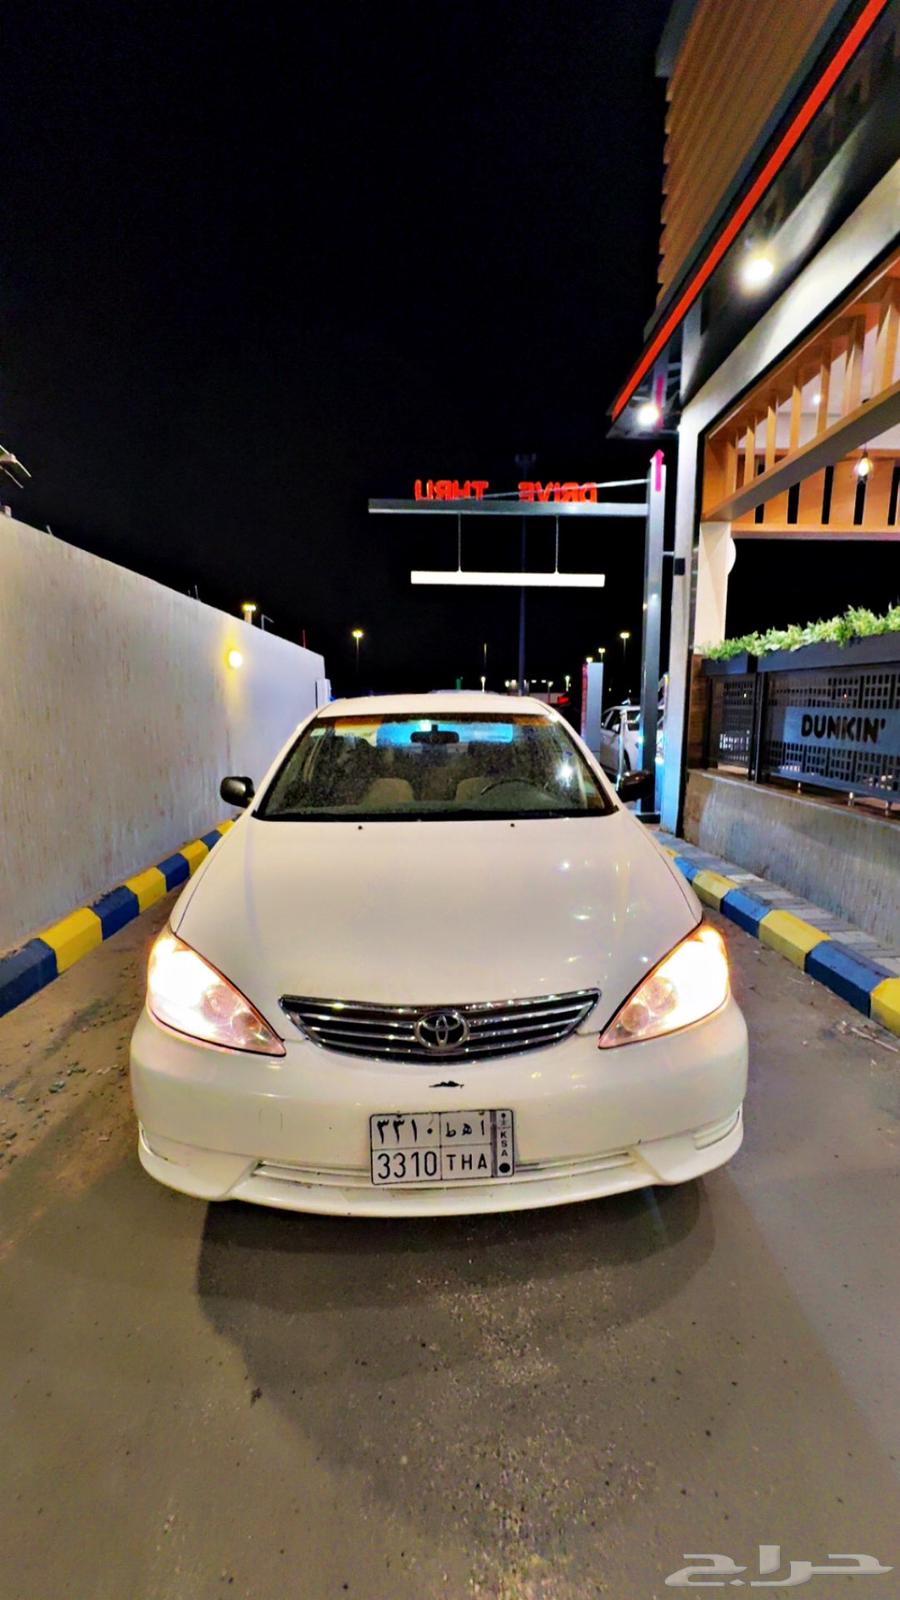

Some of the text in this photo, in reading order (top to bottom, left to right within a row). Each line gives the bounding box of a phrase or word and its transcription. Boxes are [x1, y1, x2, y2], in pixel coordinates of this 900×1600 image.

[800, 714, 886, 744] DUNKIN'
[500, 1130, 508, 1157] KSA
[377, 1151, 488, 1179] 3310 THA
